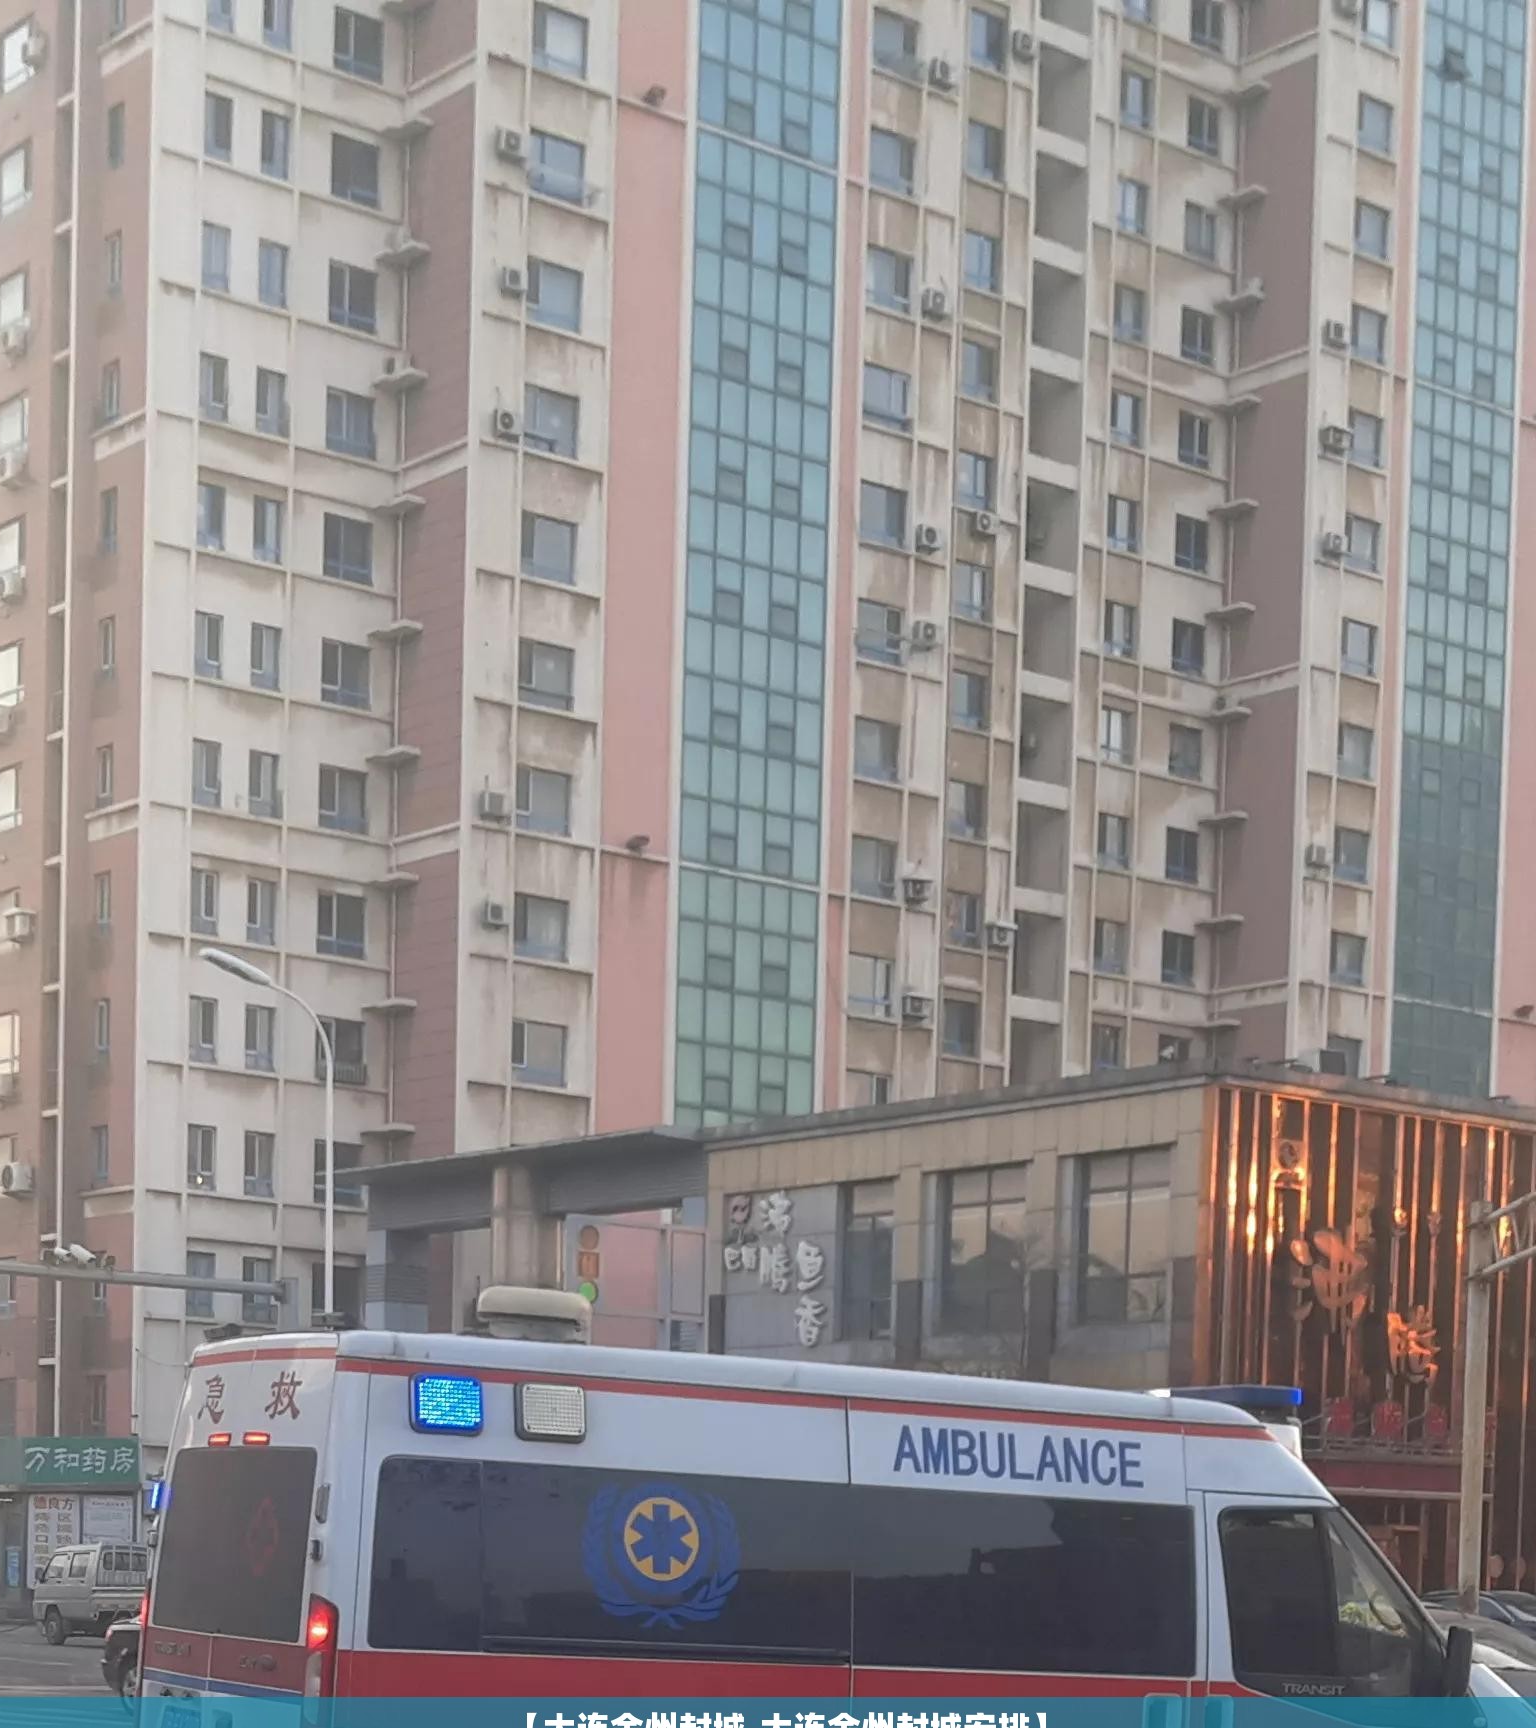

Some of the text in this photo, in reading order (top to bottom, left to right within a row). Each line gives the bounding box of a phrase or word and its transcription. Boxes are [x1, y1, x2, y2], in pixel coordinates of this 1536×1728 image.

[197, 1370, 303, 1425] 急救
[24, 1446, 136, 1474] 万和药房
[892, 1424, 1145, 1489] AMBULANCE
[1281, 1682, 1346, 1697] TRANSIT
